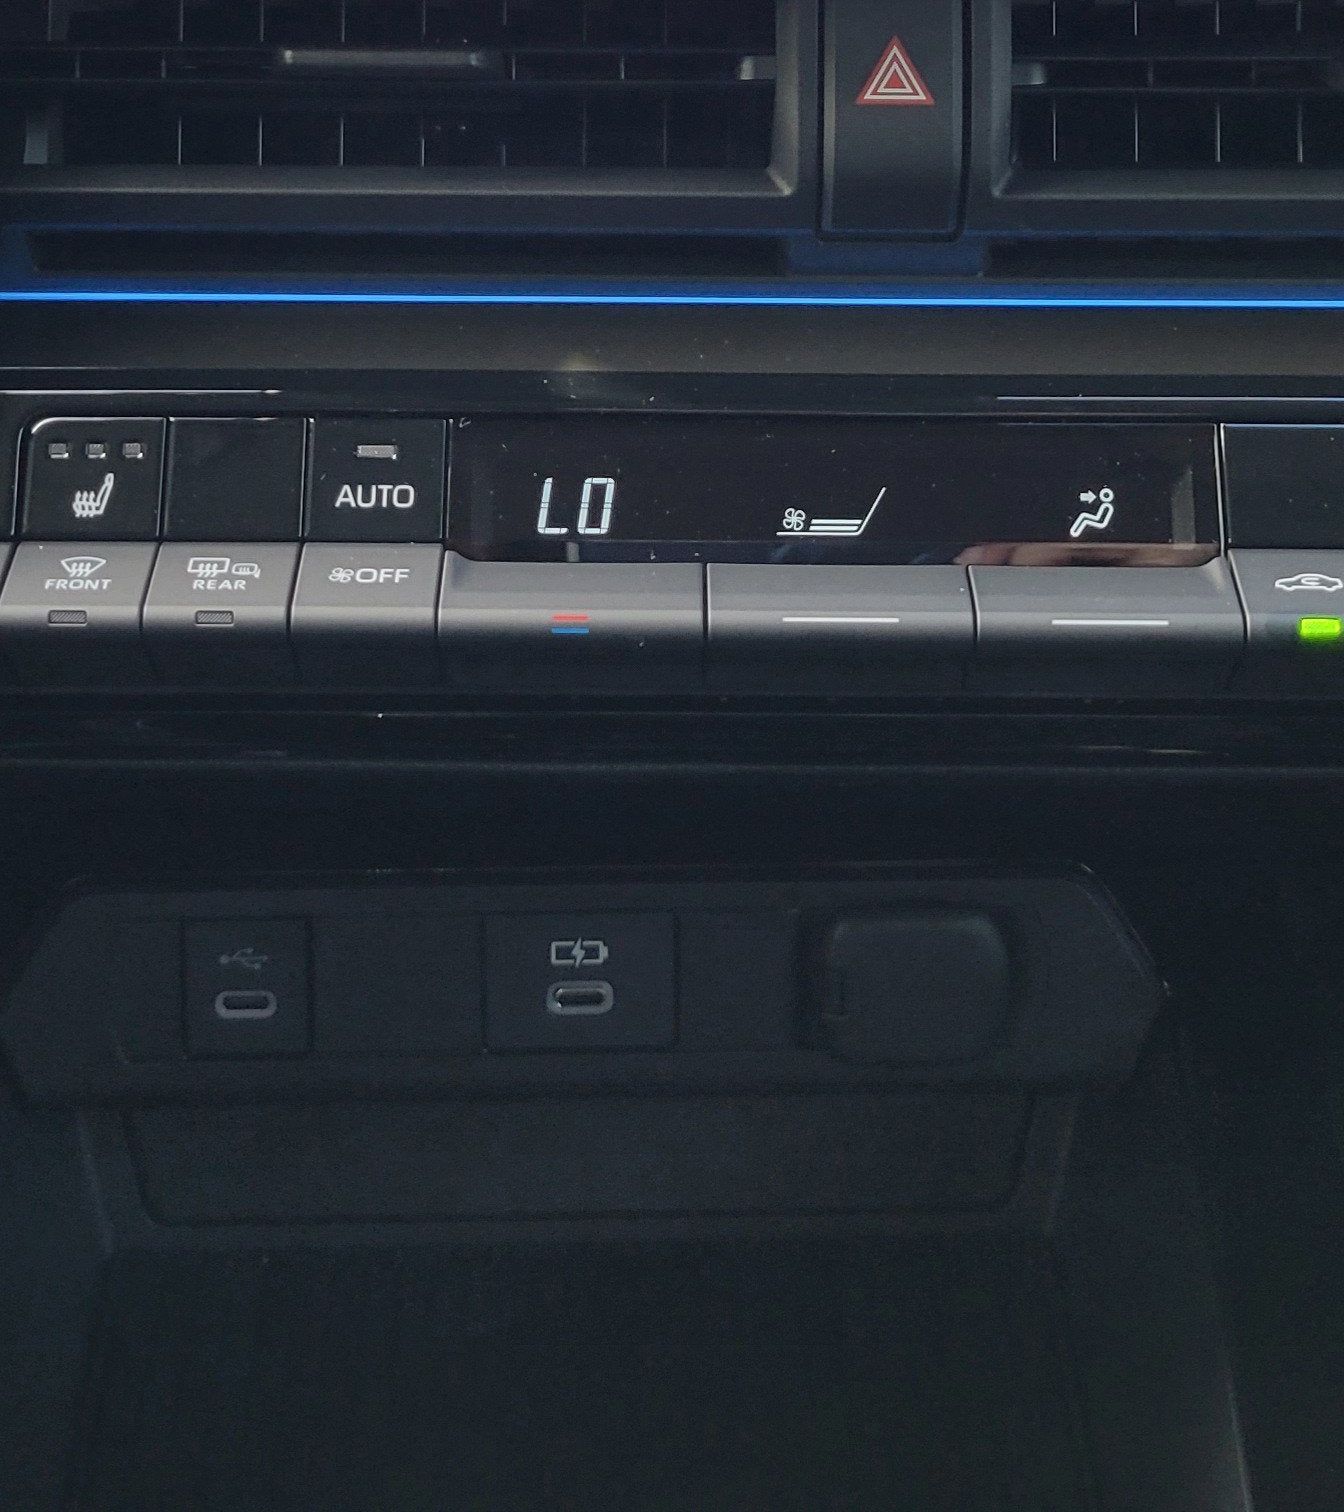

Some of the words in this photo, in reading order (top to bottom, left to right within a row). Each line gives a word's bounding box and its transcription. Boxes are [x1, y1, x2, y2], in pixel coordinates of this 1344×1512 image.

[335, 484, 415, 509] AUTO
[537, 477, 616, 534] LO
[355, 568, 410, 583] OFF
[44, 578, 112, 591] FRONT
[193, 579, 247, 591] REAR
